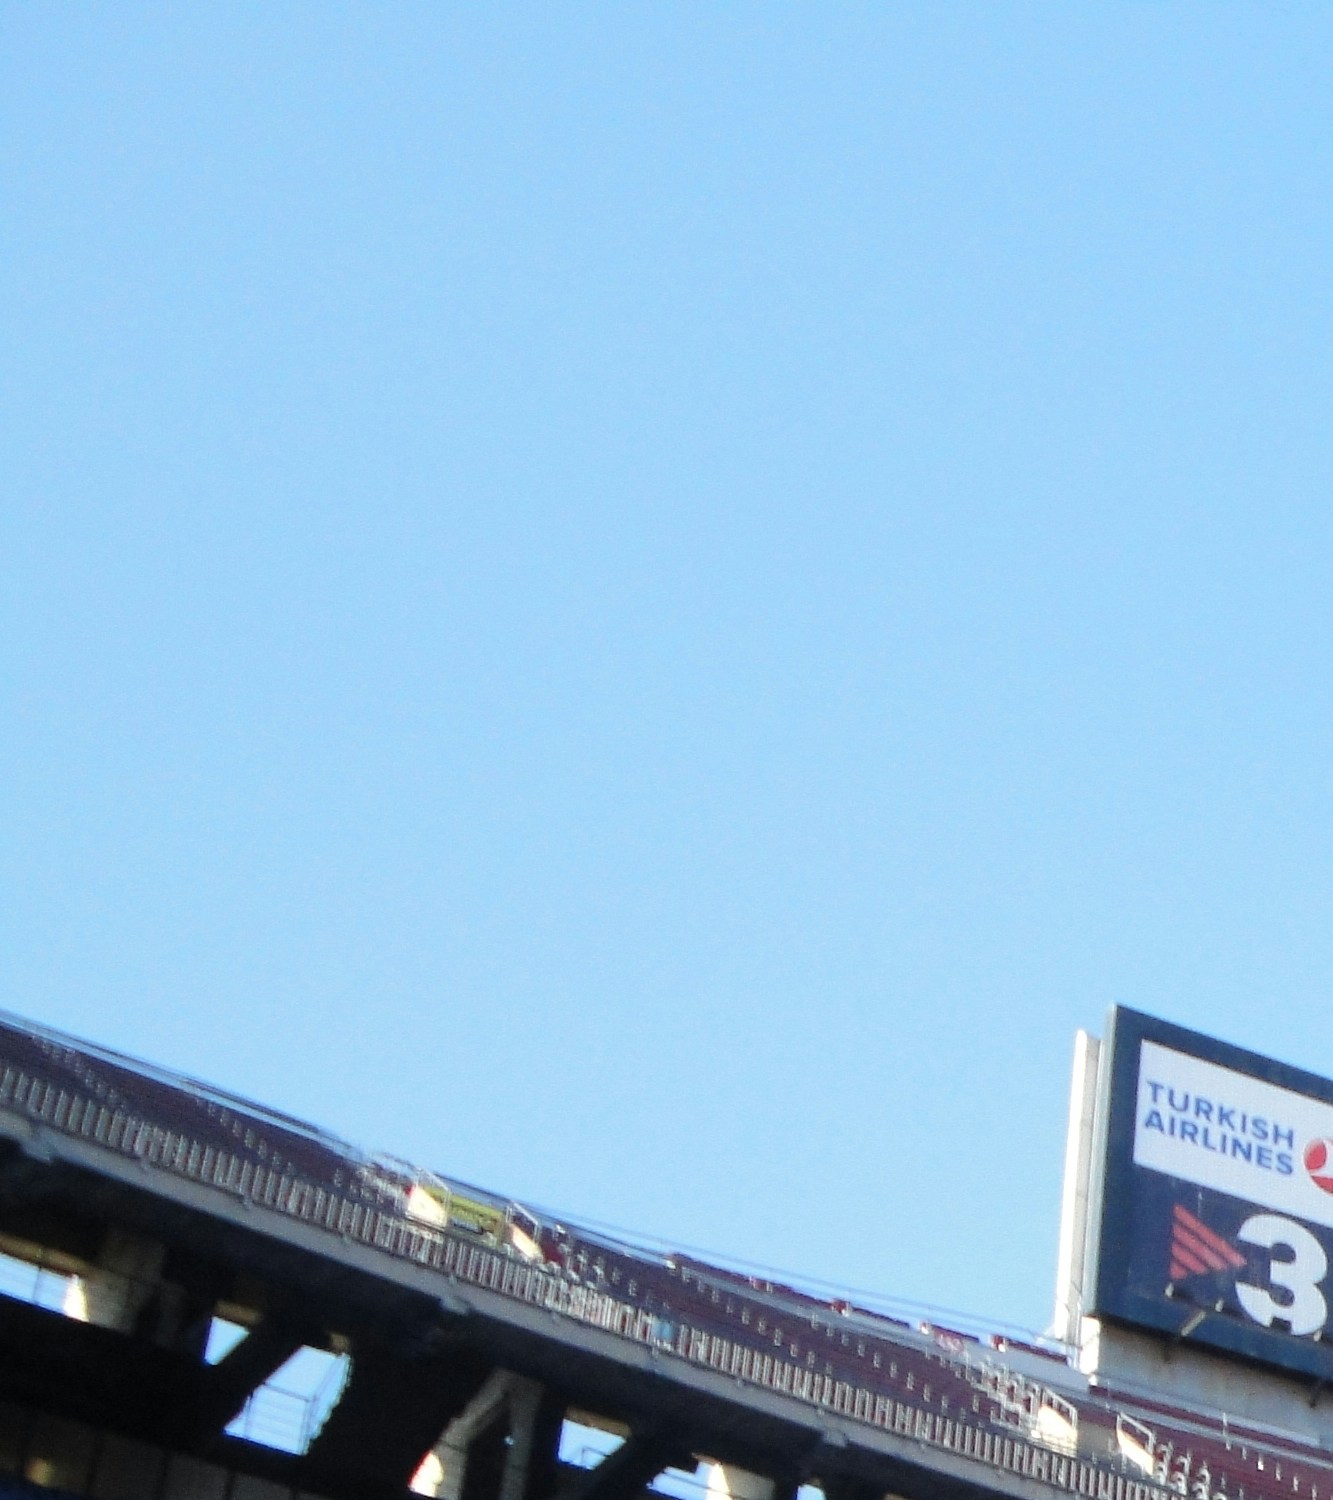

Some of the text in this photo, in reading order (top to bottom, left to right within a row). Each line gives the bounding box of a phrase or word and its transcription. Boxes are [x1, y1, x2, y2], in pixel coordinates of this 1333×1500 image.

[1144, 1108, 1294, 1176] AIRLINES
[1146, 1079, 1295, 1150] TURKISH
[1236, 1213, 1329, 1337] 3
